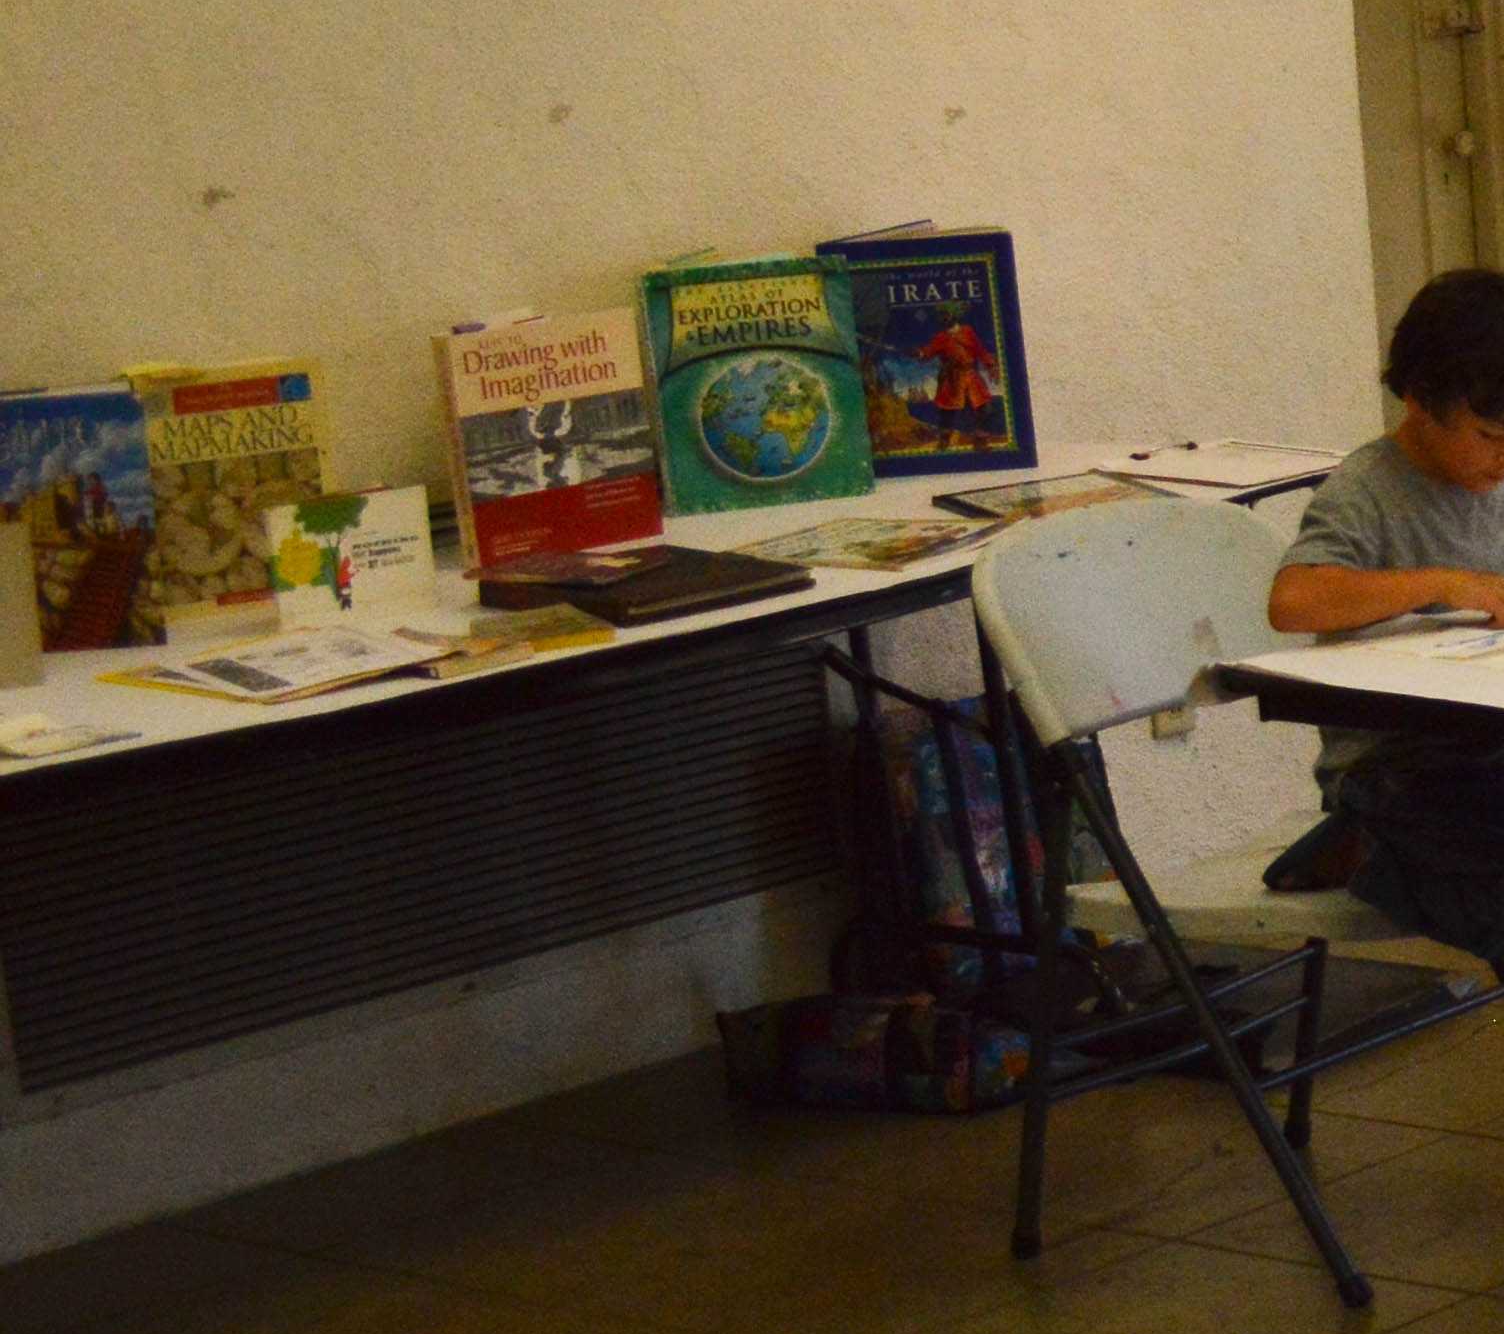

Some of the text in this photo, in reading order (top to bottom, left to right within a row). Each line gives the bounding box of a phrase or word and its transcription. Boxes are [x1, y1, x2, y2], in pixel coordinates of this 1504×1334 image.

[888, 279, 983, 304] IRATE
[679, 297, 821, 325] EXPLORATION
[697, 316, 812, 346] EMPIRES
[463, 331, 607, 375] Drawing with
[480, 359, 617, 401] Imagination
[163, 405, 298, 442] MAPS AND
[151, 424, 314, 463] MAPMAKING
